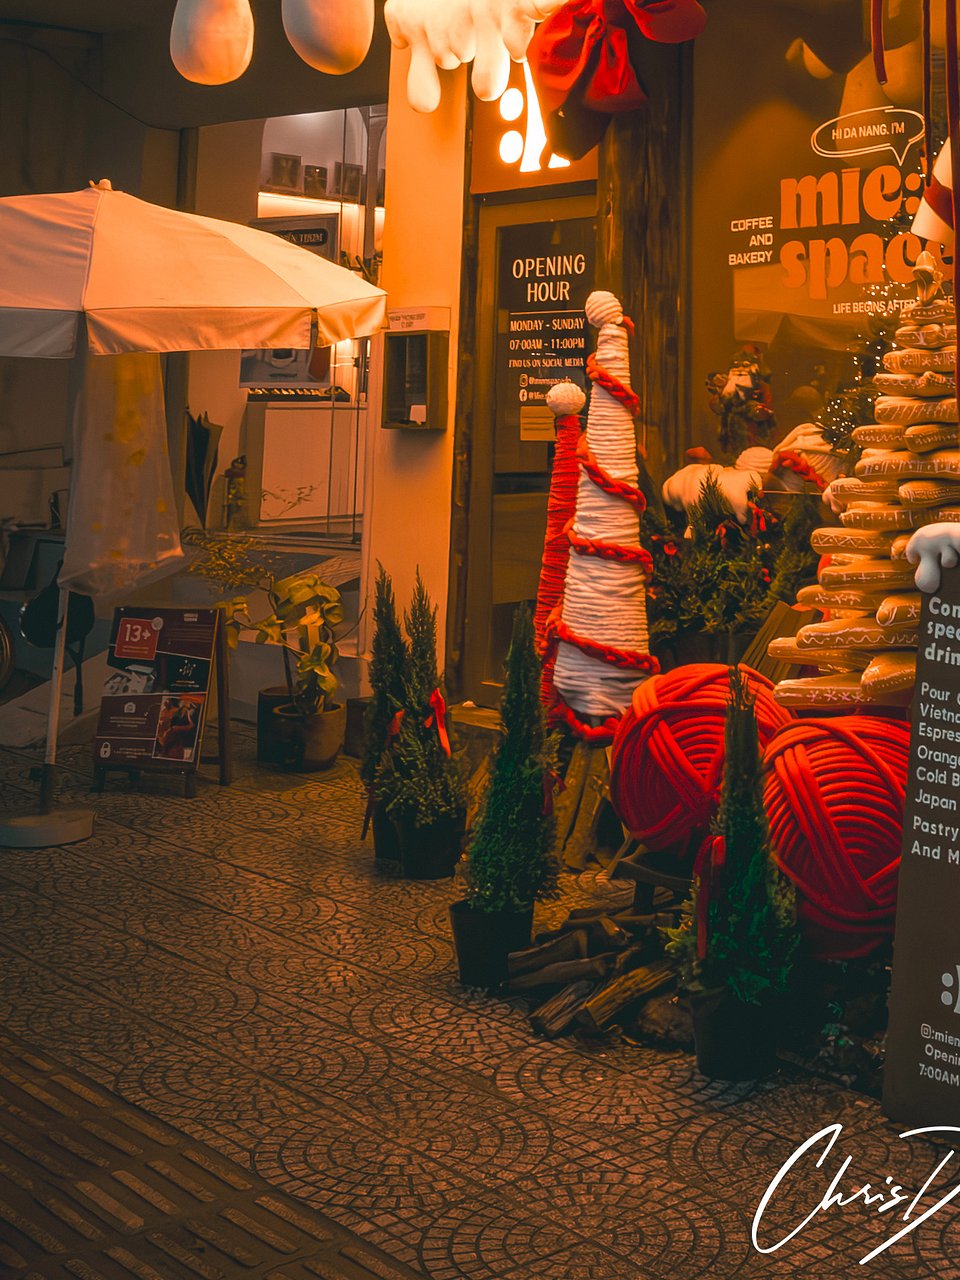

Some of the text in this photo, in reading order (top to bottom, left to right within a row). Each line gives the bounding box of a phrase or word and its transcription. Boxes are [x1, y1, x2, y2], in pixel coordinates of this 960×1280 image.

[831, 129, 842, 140] HI
[843, 127, 857, 139] DA
[859, 123, 889, 137] NANG.
[731, 216, 773, 232] COFFEE
[749, 233, 774, 247] AND
[512, 254, 586, 279] OPENING
[728, 250, 773, 266] BAKERY
[527, 281, 570, 303] HOUR
[833, 302, 851, 314] LIFE
[853, 300, 886, 313] BEGINS
[510, 320, 544, 331] MONDAY
[552, 318, 585, 330] SUNDAY
[551, 338, 585, 349] 11:00PM
[542, 358, 563, 368] SOCIAL
[564, 357, 585, 367] MEDIA
[921, 682, 950, 701] Pour
[916, 767, 947, 785] Cold
[915, 790, 957, 812] Japan
[913, 816, 960, 841] Pastry
[911, 841, 941, 860] And
[919, 1063, 960, 1087] 7:00AM
